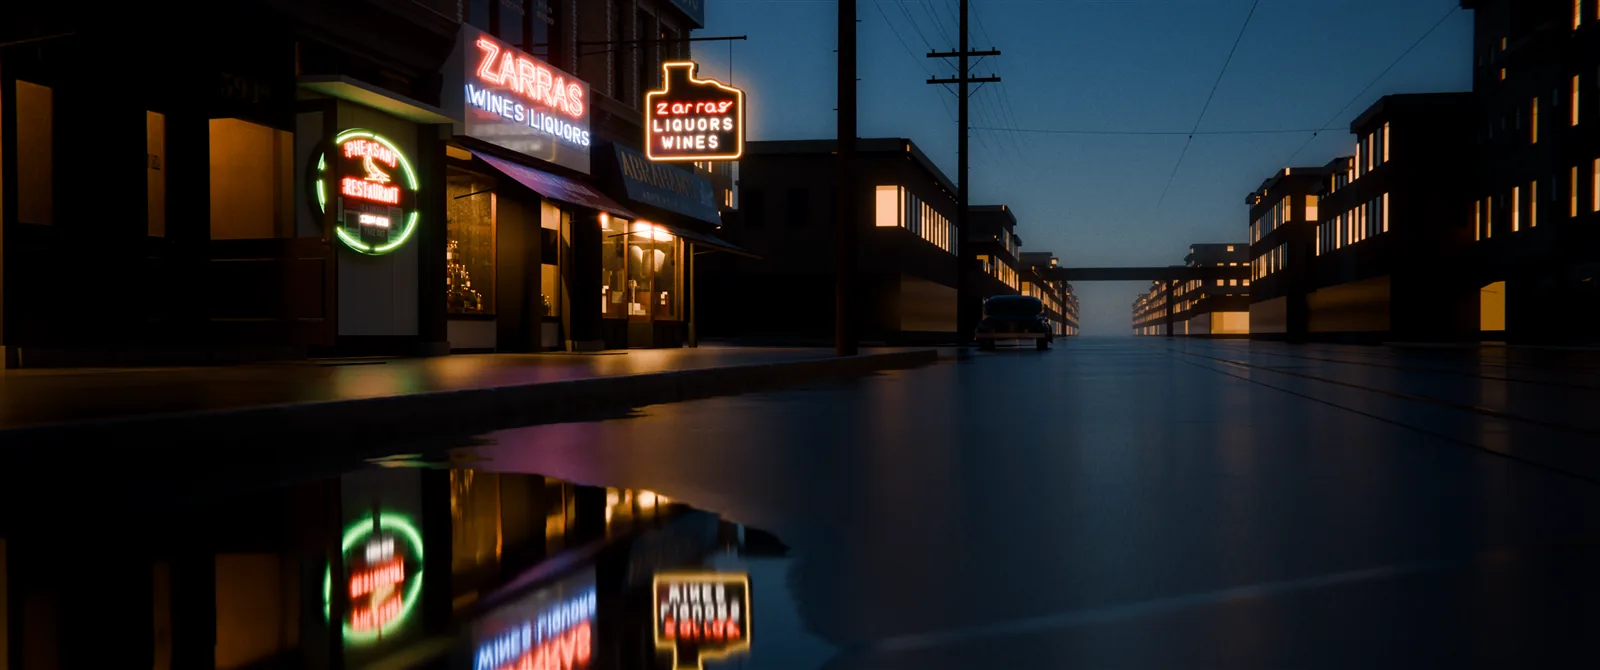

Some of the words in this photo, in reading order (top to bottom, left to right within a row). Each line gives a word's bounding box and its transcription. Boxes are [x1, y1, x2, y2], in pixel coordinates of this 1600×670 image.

[477, 39, 583, 116] ZARRAS
[465, 83, 525, 121] WINES
[527, 108, 590, 146] LIQUORS
[656, 101, 733, 114] zarras
[653, 117, 733, 132] LIQUORS
[344, 139, 398, 168] PHEASANT
[661, 135, 718, 150] WINES
[342, 178, 399, 204] RESTAURANT
